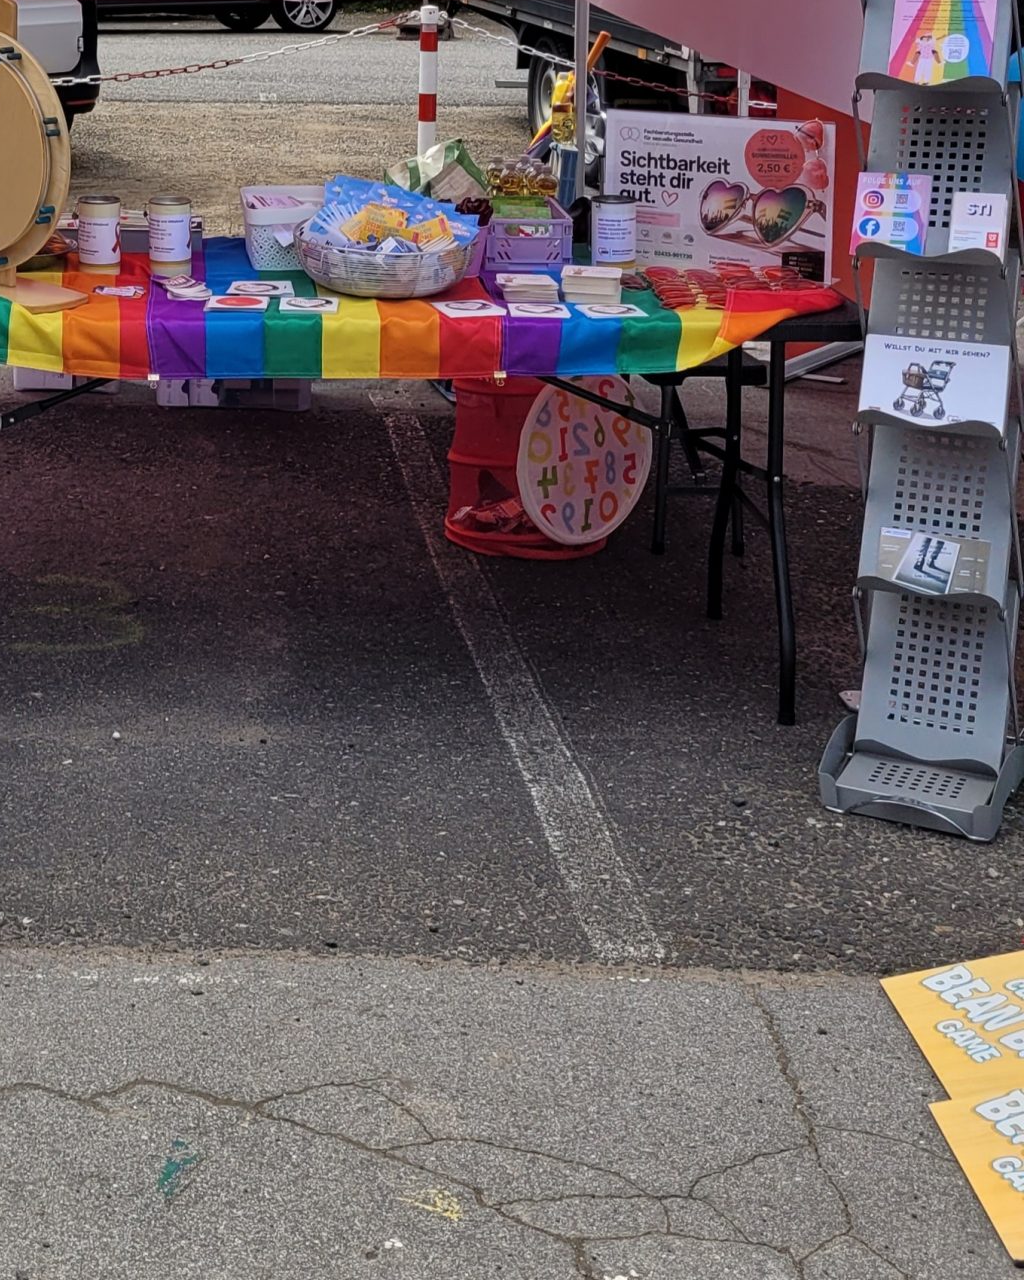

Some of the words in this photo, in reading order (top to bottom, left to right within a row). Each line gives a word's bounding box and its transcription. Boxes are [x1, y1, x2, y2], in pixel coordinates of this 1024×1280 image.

[620, 150, 731, 175] Sichtbarkeit
[757, 163, 780, 173] 2,50
[783, 164, 791, 173] €
[620, 169, 665, 187] steht
[670, 172, 694, 189] dir
[966, 202, 993, 217] STI
[884, 343, 912, 352] WILLST
[921, 963, 1024, 1032] BEAN
[936, 1019, 1003, 1063] GAME
[974, 1088, 1024, 1146] BE
[991, 1156, 1024, 1193] GA
